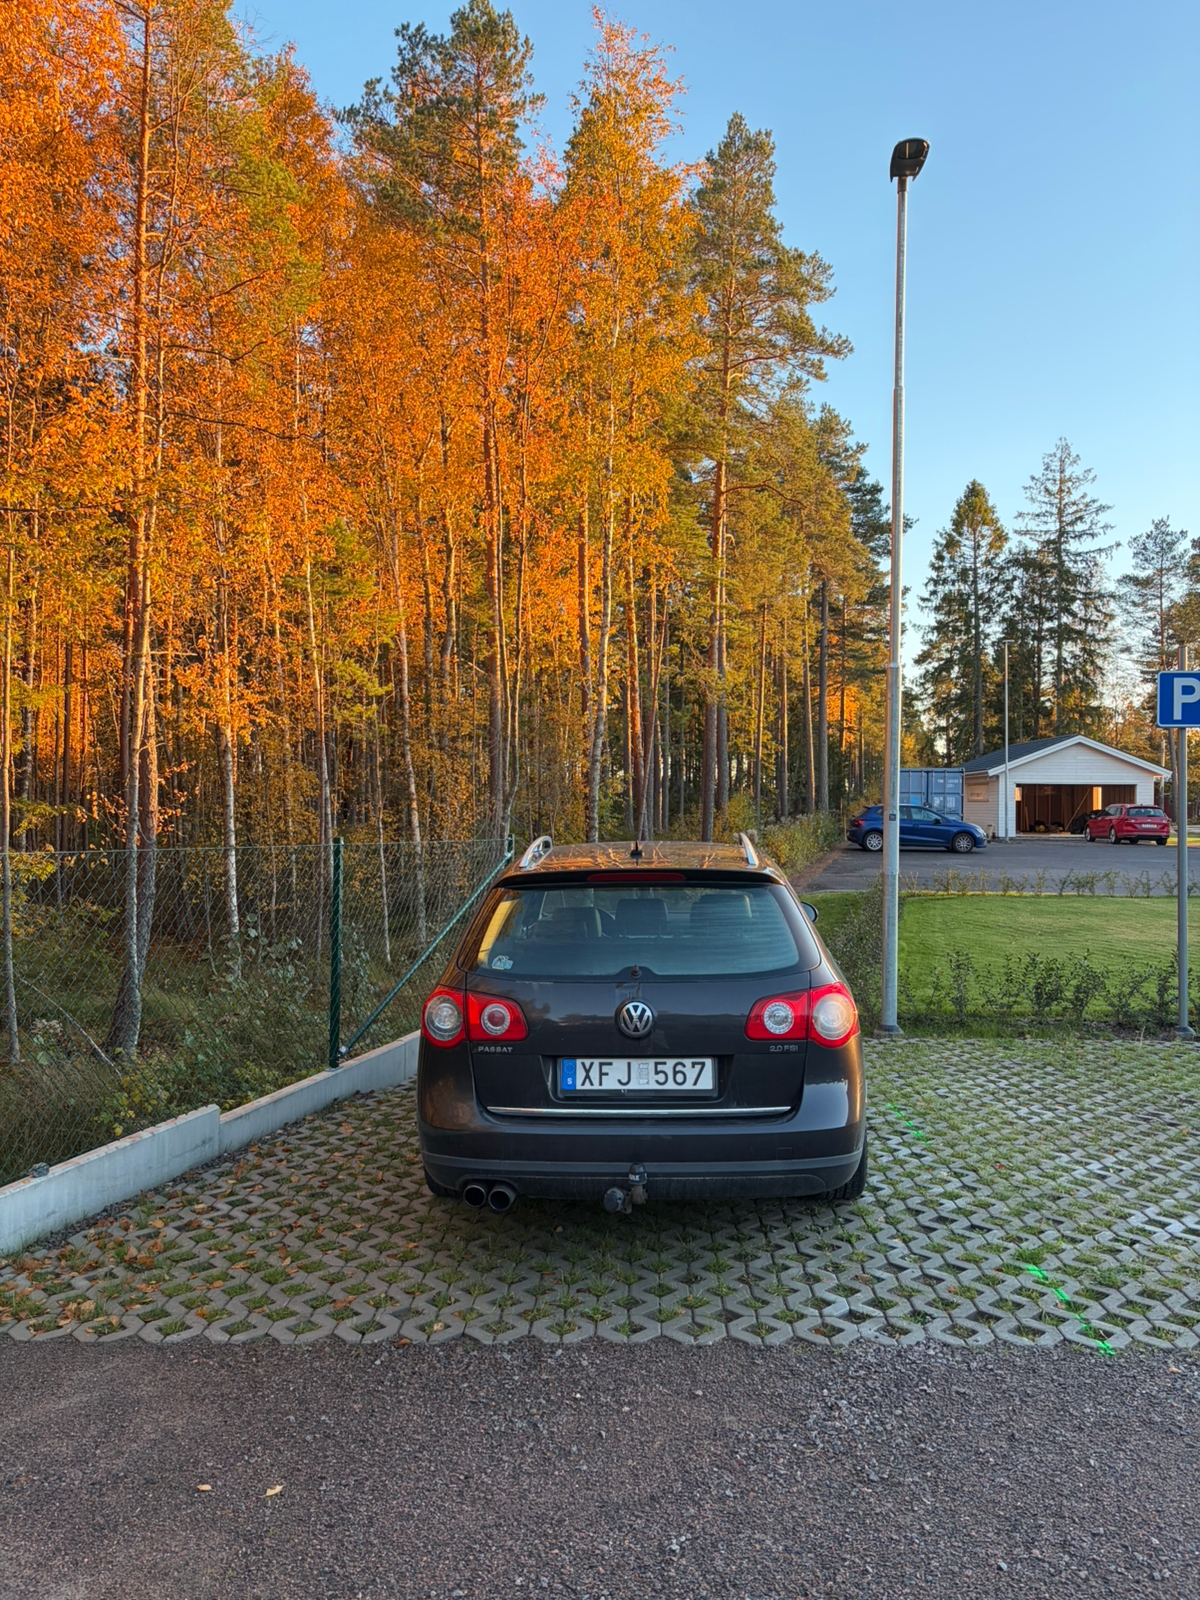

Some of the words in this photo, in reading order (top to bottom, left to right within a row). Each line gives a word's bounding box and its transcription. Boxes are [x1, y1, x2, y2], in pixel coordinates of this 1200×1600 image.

[1173, 677, 1200, 720] P
[620, 1001, 653, 1037] VW
[477, 1045, 513, 1053] PASSAT
[783, 1044, 799, 1052] FSI
[567, 1077, 573, 1085] S
[580, 1061, 632, 1087] XFJ
[654, 1061, 706, 1087] 567
